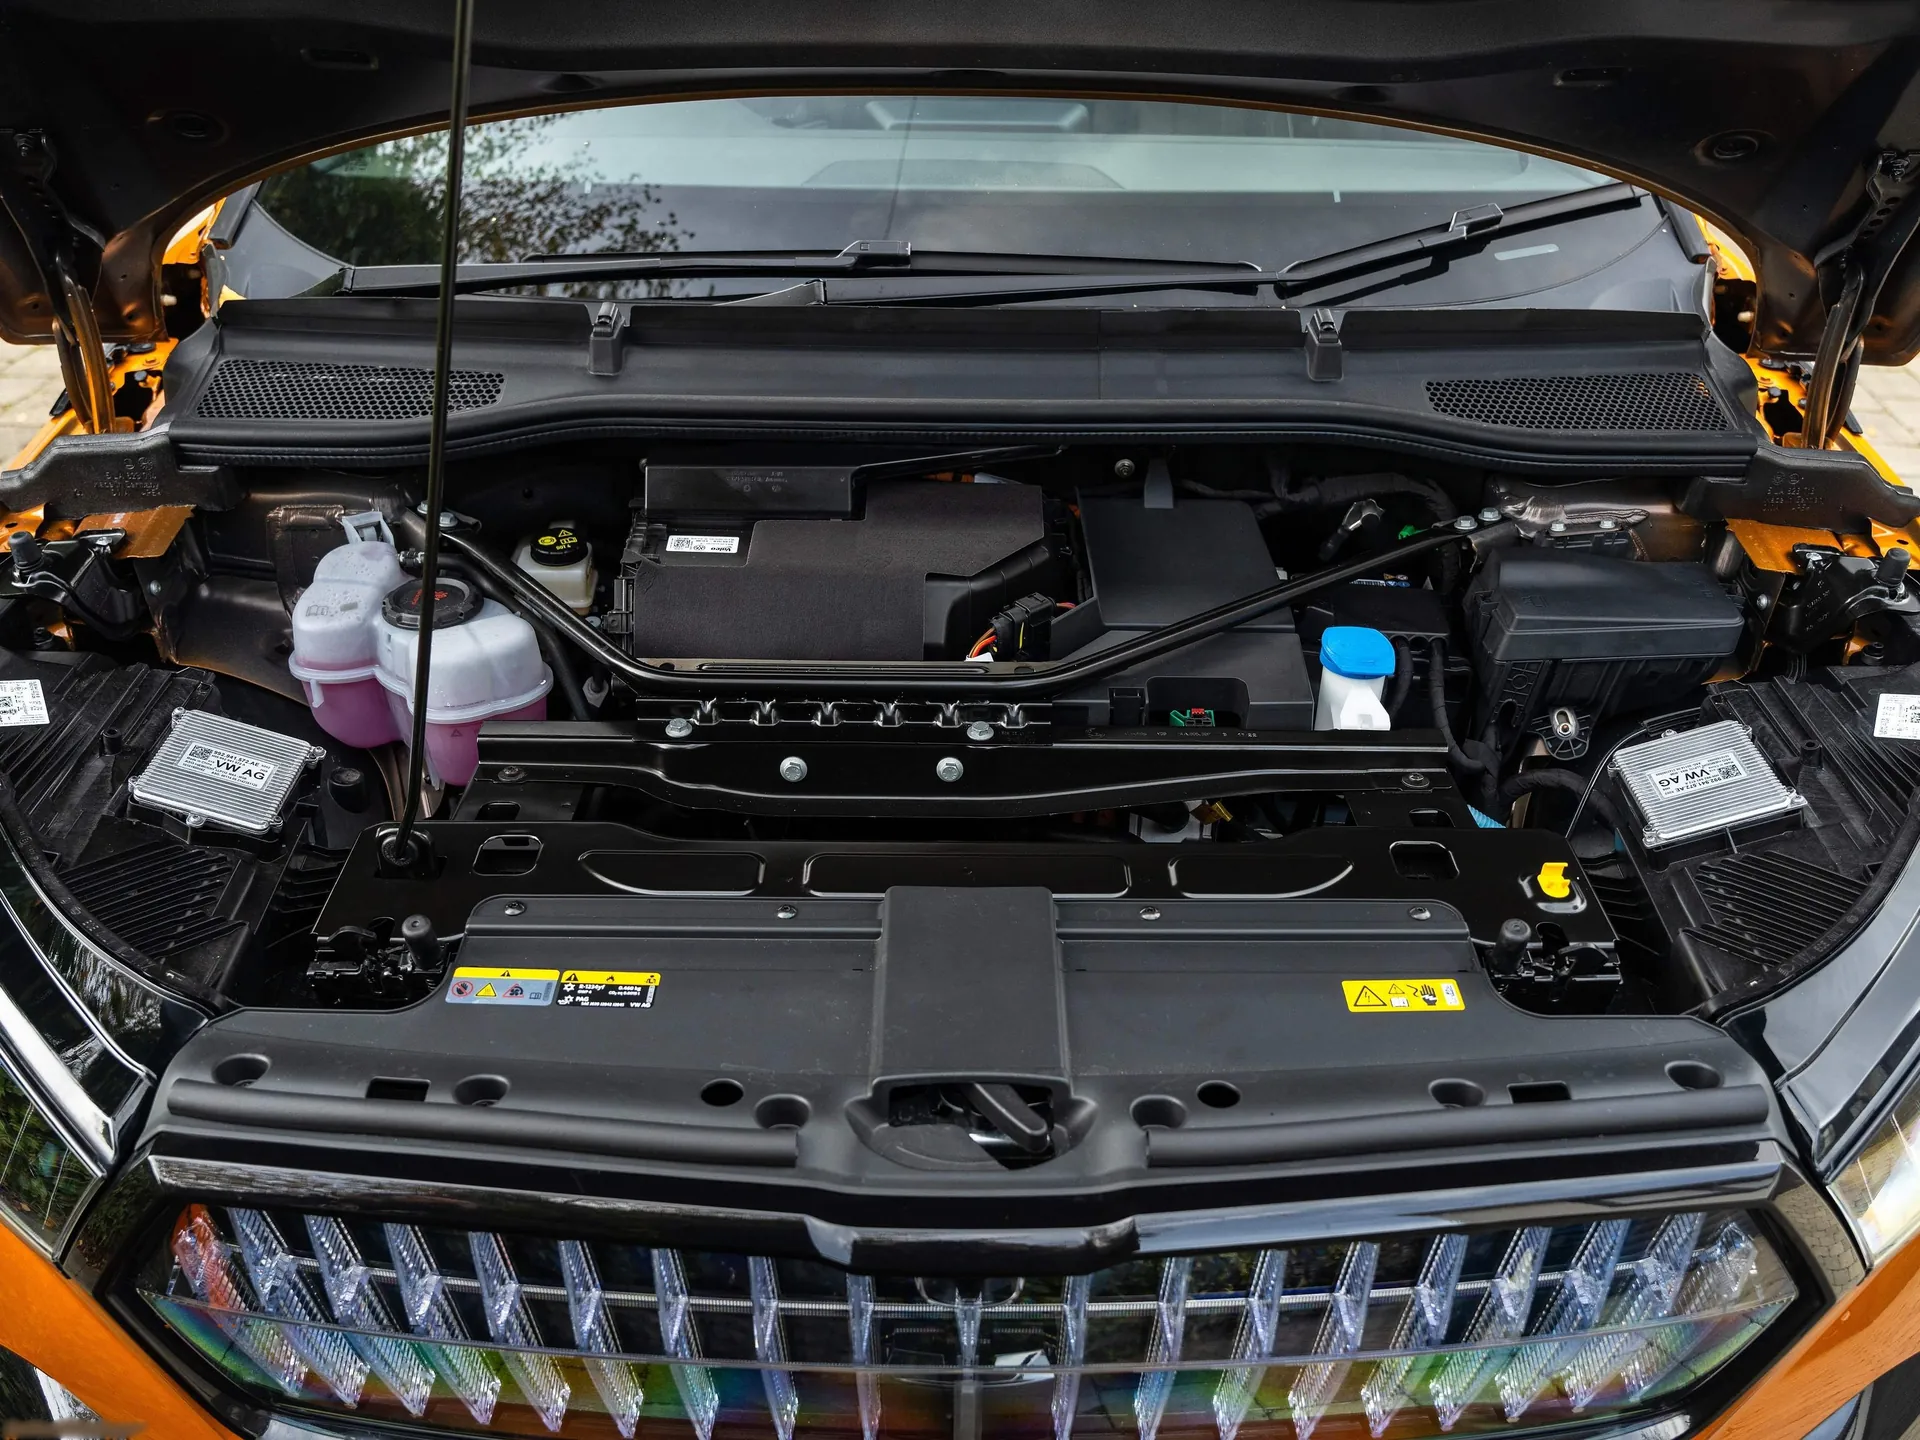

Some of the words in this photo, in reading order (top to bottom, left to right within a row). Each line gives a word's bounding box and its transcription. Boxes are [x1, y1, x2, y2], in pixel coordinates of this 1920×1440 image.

[216, 759, 241, 773] VW
[241, 768, 265, 780] AG
[1684, 769, 1710, 781] VW
[1658, 775, 1679, 787] AG
